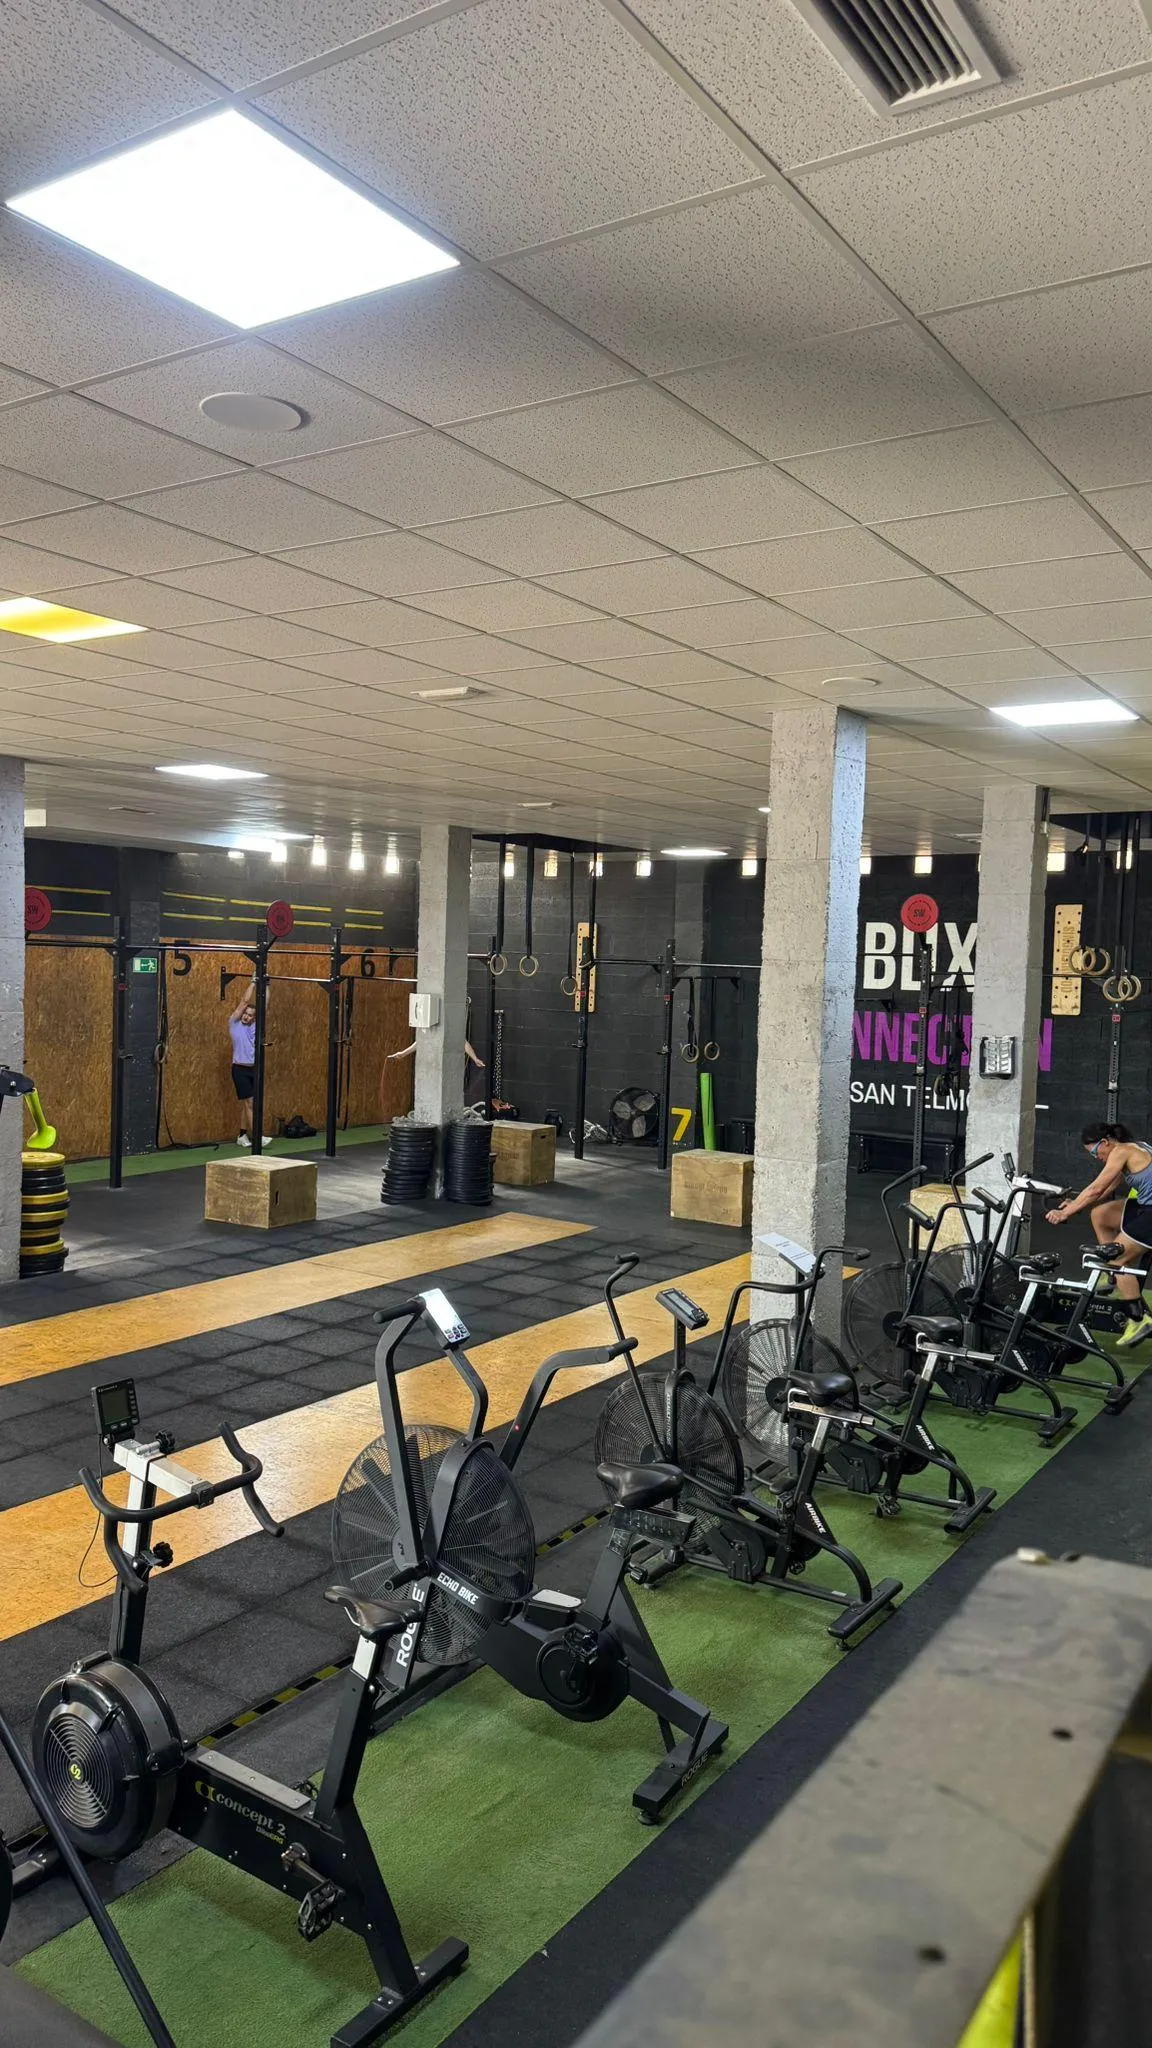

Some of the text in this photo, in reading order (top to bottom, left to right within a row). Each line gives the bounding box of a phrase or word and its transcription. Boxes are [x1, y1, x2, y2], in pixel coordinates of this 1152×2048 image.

[173, 940, 192, 976] 5
[361, 948, 376, 978] 6
[850, 1081, 971, 1111] SAN TELM
[671, 1107, 692, 1142] 7
[915, 1424, 936, 1451] AIRBIKE
[804, 1502, 827, 1534] AIRBIKE
[437, 1571, 479, 1605] ECHO BIKE
[215, 1793, 275, 1829] concept
[276, 1823, 287, 1836] 2
